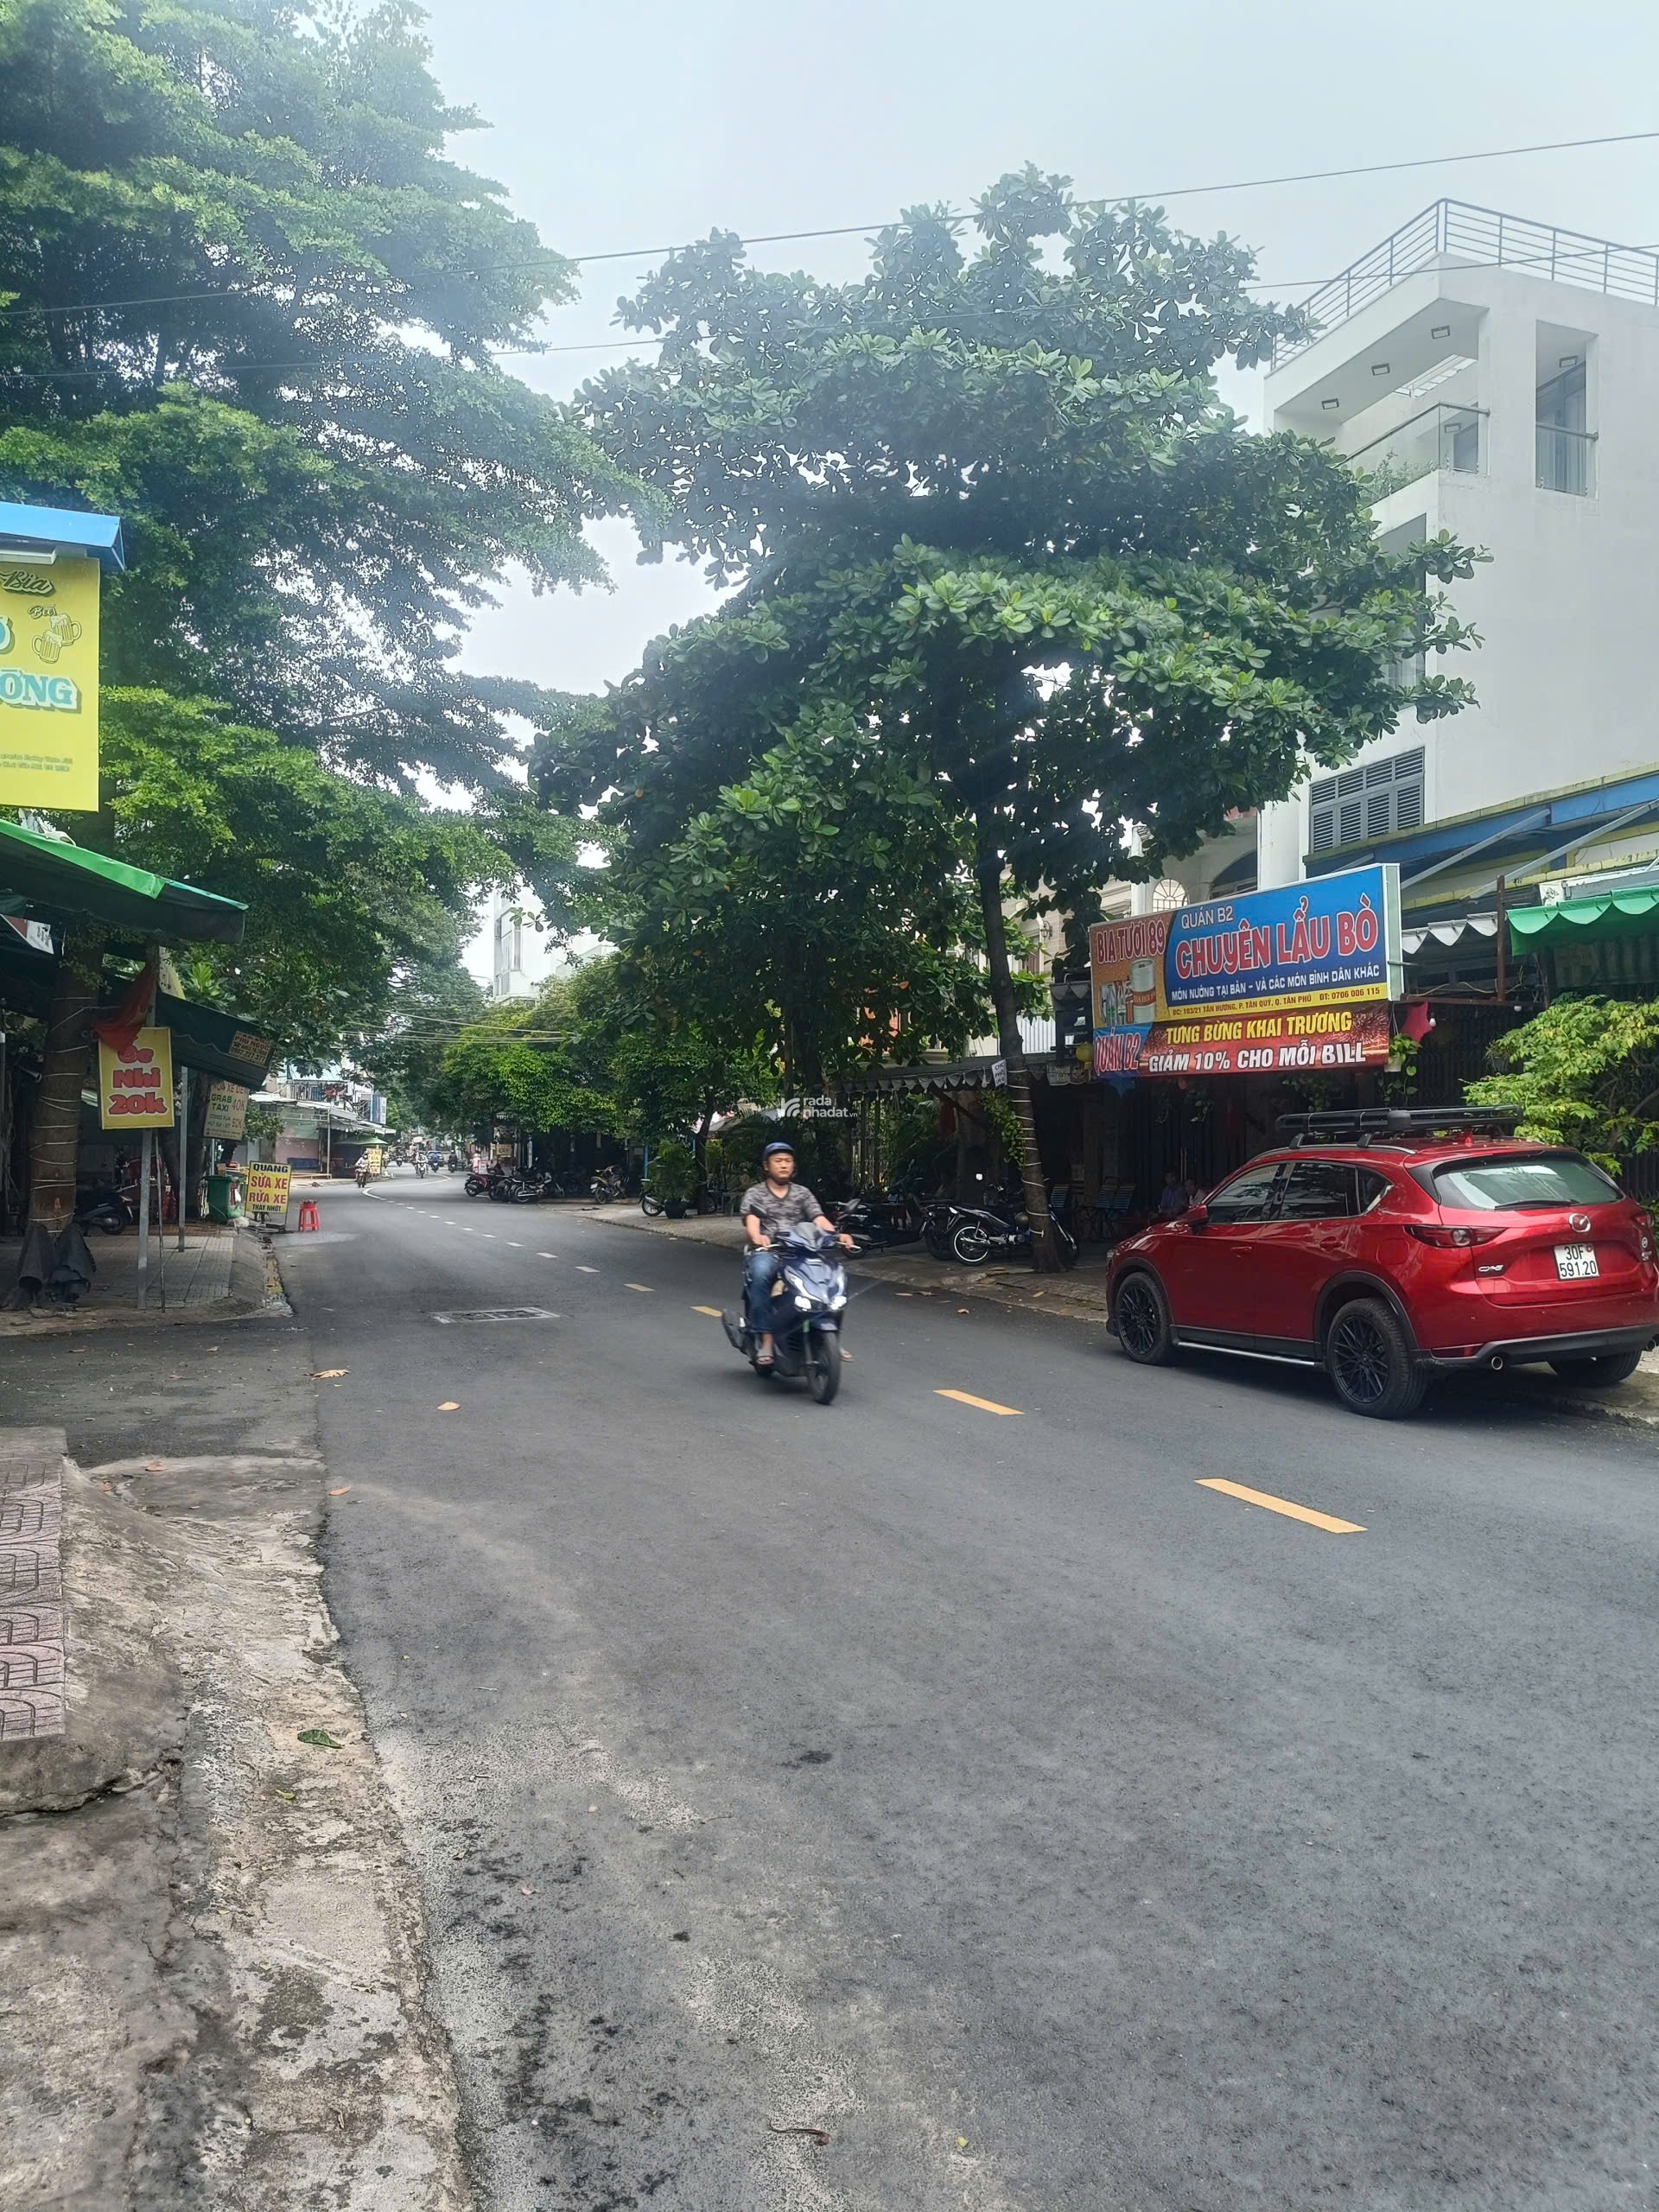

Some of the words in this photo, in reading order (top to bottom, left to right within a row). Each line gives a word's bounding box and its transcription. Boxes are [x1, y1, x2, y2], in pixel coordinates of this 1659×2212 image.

[1181, 906, 1214, 930] QUÁN
[1217, 906, 1234, 924] B2
[1096, 929, 1117, 964] BIA
[1117, 921, 1147, 960] TƯƠI
[1148, 919, 1166, 957] 89
[1176, 918, 1271, 979] CHUYÊN
[1276, 896, 1331, 965] LẨU
[1337, 892, 1378, 957] BÒ
[1172, 987, 1187, 1001] MÓN
[1190, 985, 1214, 999] NƯỚNG
[1217, 985, 1229, 997] TẠI
[1230, 981, 1246, 995] BÀN
[1255, 976, 1267, 991] VÀ
[1269, 975, 1286, 989] CÁC
[1287, 971, 1306, 988] MÓN
[1309, 969, 1329, 985] BÌNH
[1332, 967, 1351, 982] DÂN
[1354, 962, 1380, 980] KHÁC
[1166, 1025, 1200, 1045] TƯNG
[1204, 1020, 1243, 1043] BỪNG
[1247, 1017, 1282, 1039] KHAI
[1287, 1011, 1353, 1036] TRƯƠNG
[1094, 1027, 1124, 1077] QUÁN
[1124, 1033, 1141, 1071] B2
[1148, 1049, 1190, 1072] GIẢM
[1194, 1051, 1231, 1071] 10%
[1237, 1048, 1274, 1069] CHO
[1279, 1039, 1317, 1066] MỖI
[1321, 1041, 1366, 1065] BILL
[108, 1092, 168, 1115] 20k
[212, 1094, 232, 1103] GRAB
[213, 1103, 229, 1112] TAXI
[253, 1164, 288, 1173] QUANG
[251, 1173, 271, 1188] SỬA
[275, 1177, 288, 1190] XE
[249, 1190, 270, 1203] RỬA
[273, 1194, 286, 1204] XE
[1564, 1245, 1584, 1261] 30F
[1559, 1261, 1597, 1278] 591.20
